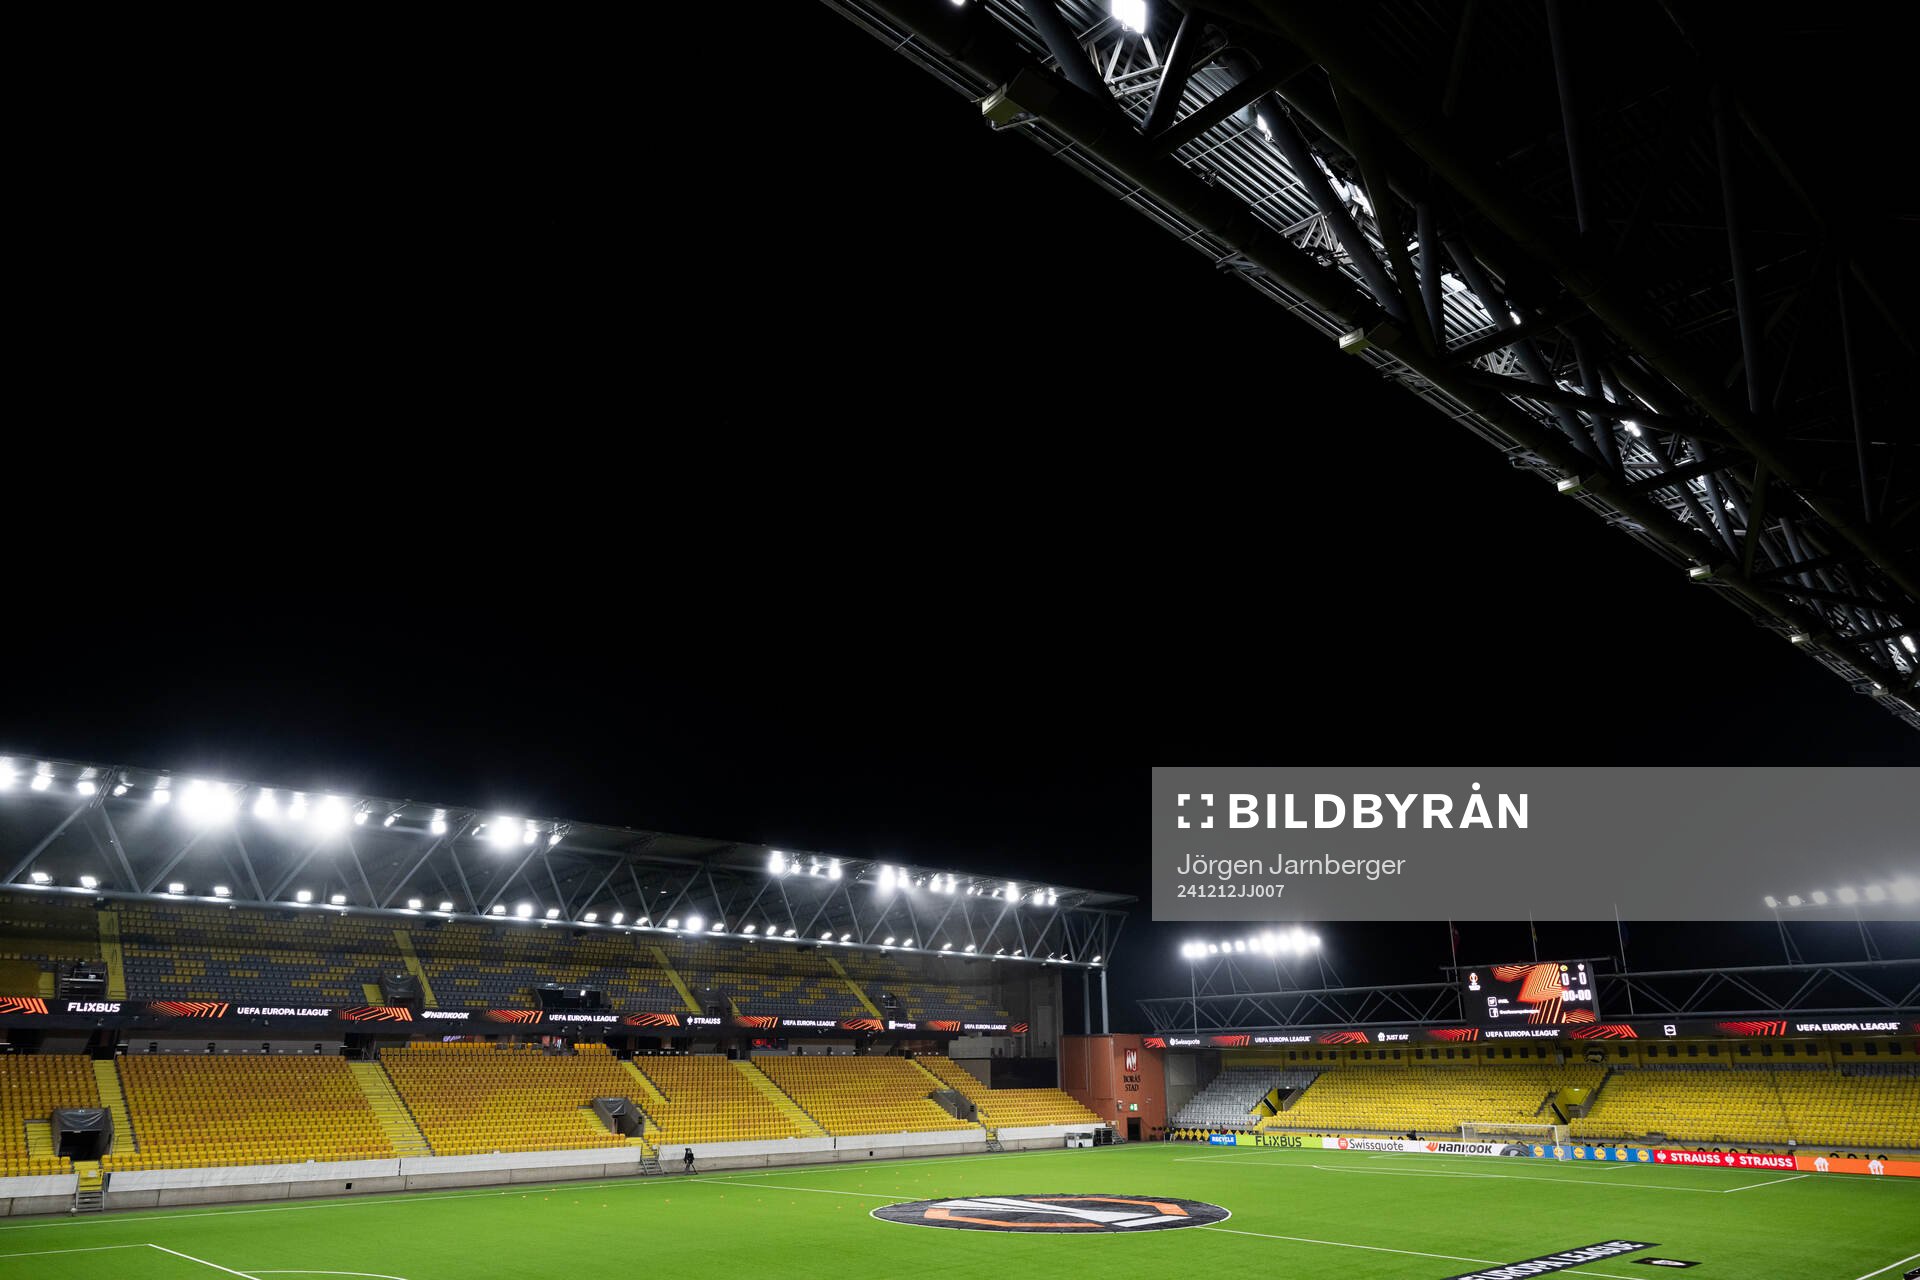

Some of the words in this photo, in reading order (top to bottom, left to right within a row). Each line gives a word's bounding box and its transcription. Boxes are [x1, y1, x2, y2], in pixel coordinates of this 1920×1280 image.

[237, 1007, 261, 1015] UEFA
[262, 1008, 295, 1016] EUROPA
[297, 1009, 330, 1017] LEAGUE
[549, 1014, 567, 1022] UEFA
[568, 1015, 593, 1023] EUROPA
[694, 1016, 721, 1025] STRAUSS
[783, 1018, 797, 1026] UEFA
[797, 1019, 816, 1027] EUROPA
[816, 1019, 834, 1027] LEAGUE
[1797, 1023, 1822, 1032] UEFA
[1822, 1023, 1860, 1031] EUROPA
[1860, 1022, 1899, 1031] LEAGUE
[1486, 1030, 1504, 1038] UEFA
[1504, 1030, 1531, 1038] EUROPA
[1532, 1029, 1559, 1037] LEAGUE
[1290, 1035, 1311, 1043] LEAGUE
[1350, 1138, 1404, 1152] Swissquote
[1671, 1152, 1721, 1164] STRAUSS
[1739, 1156, 1793, 1168] STRAUSS
[1549, 1240, 1645, 1262] LEAGUE
